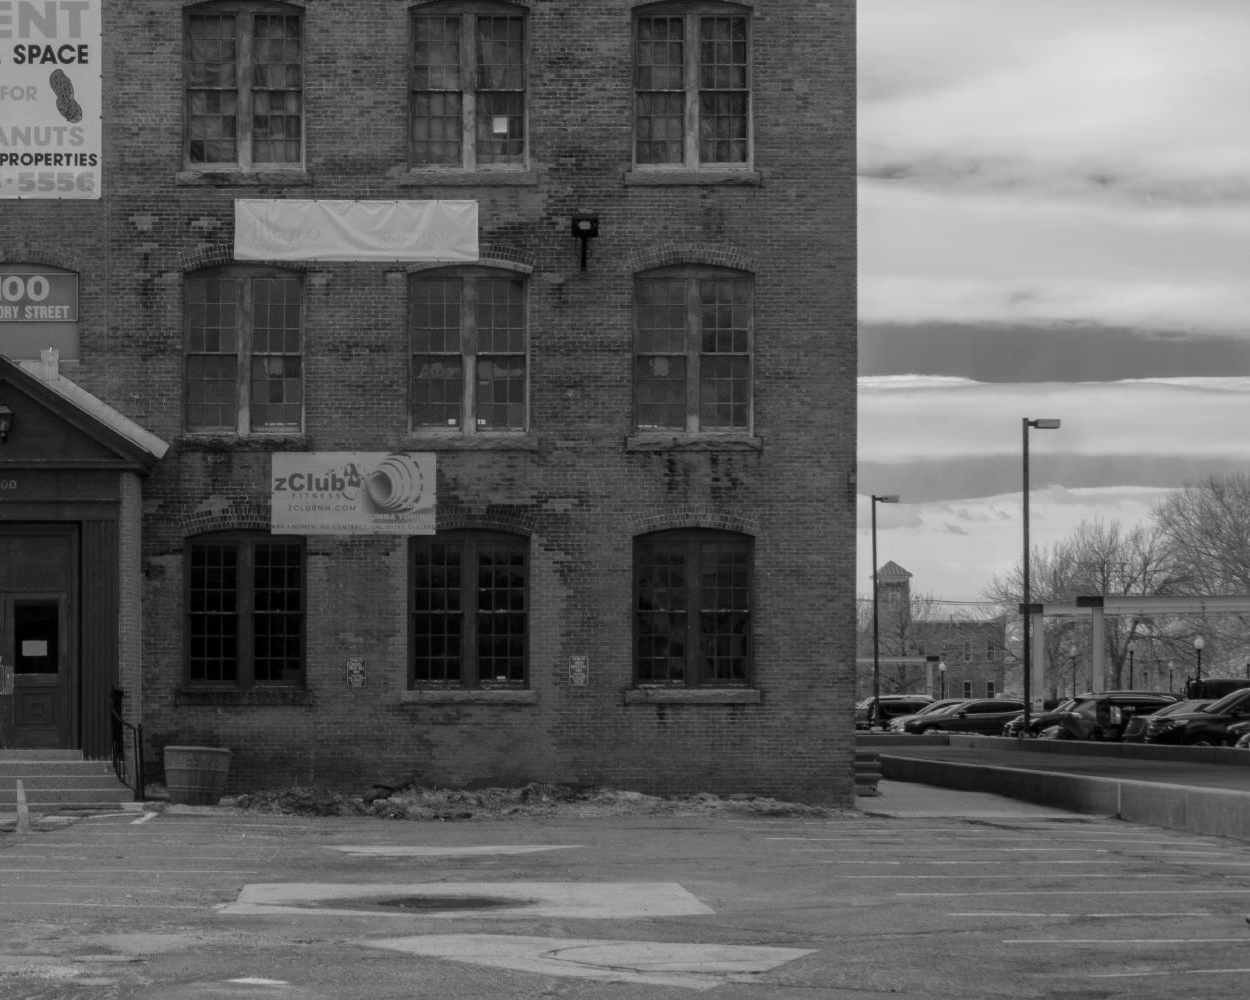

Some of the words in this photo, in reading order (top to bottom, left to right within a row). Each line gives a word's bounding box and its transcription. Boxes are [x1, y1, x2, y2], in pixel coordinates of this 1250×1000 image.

[13, 44, 89, 65] SPACE
[0, 85, 38, 101] FOR
[0, 152, 98, 167] PROPERTIES
[25, 305, 70, 319] STREET
[274, 473, 345, 491] zClub
